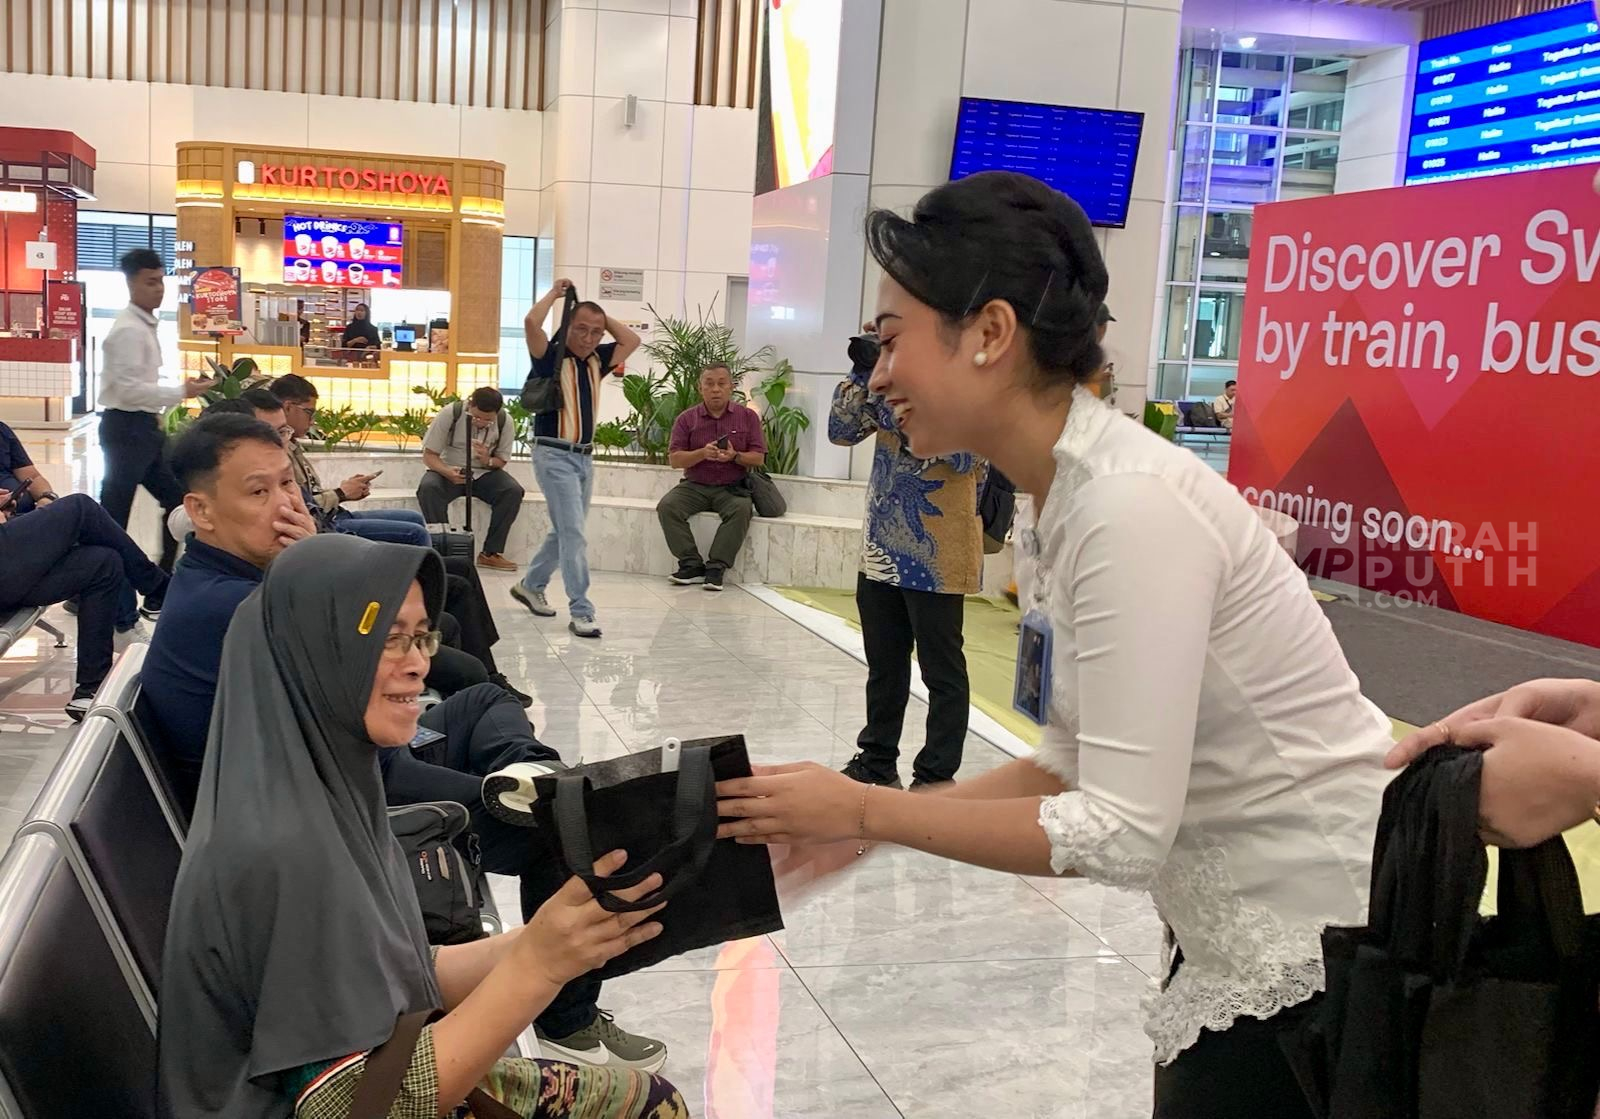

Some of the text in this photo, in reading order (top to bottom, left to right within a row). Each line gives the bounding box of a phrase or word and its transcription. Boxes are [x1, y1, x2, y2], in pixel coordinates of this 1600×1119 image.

[260, 163, 450, 196] KURTOSHOYA
[1263, 231, 1502, 293] Discover
[1255, 302, 1600, 383] by train, bus
[1242, 484, 1353, 544] coming
